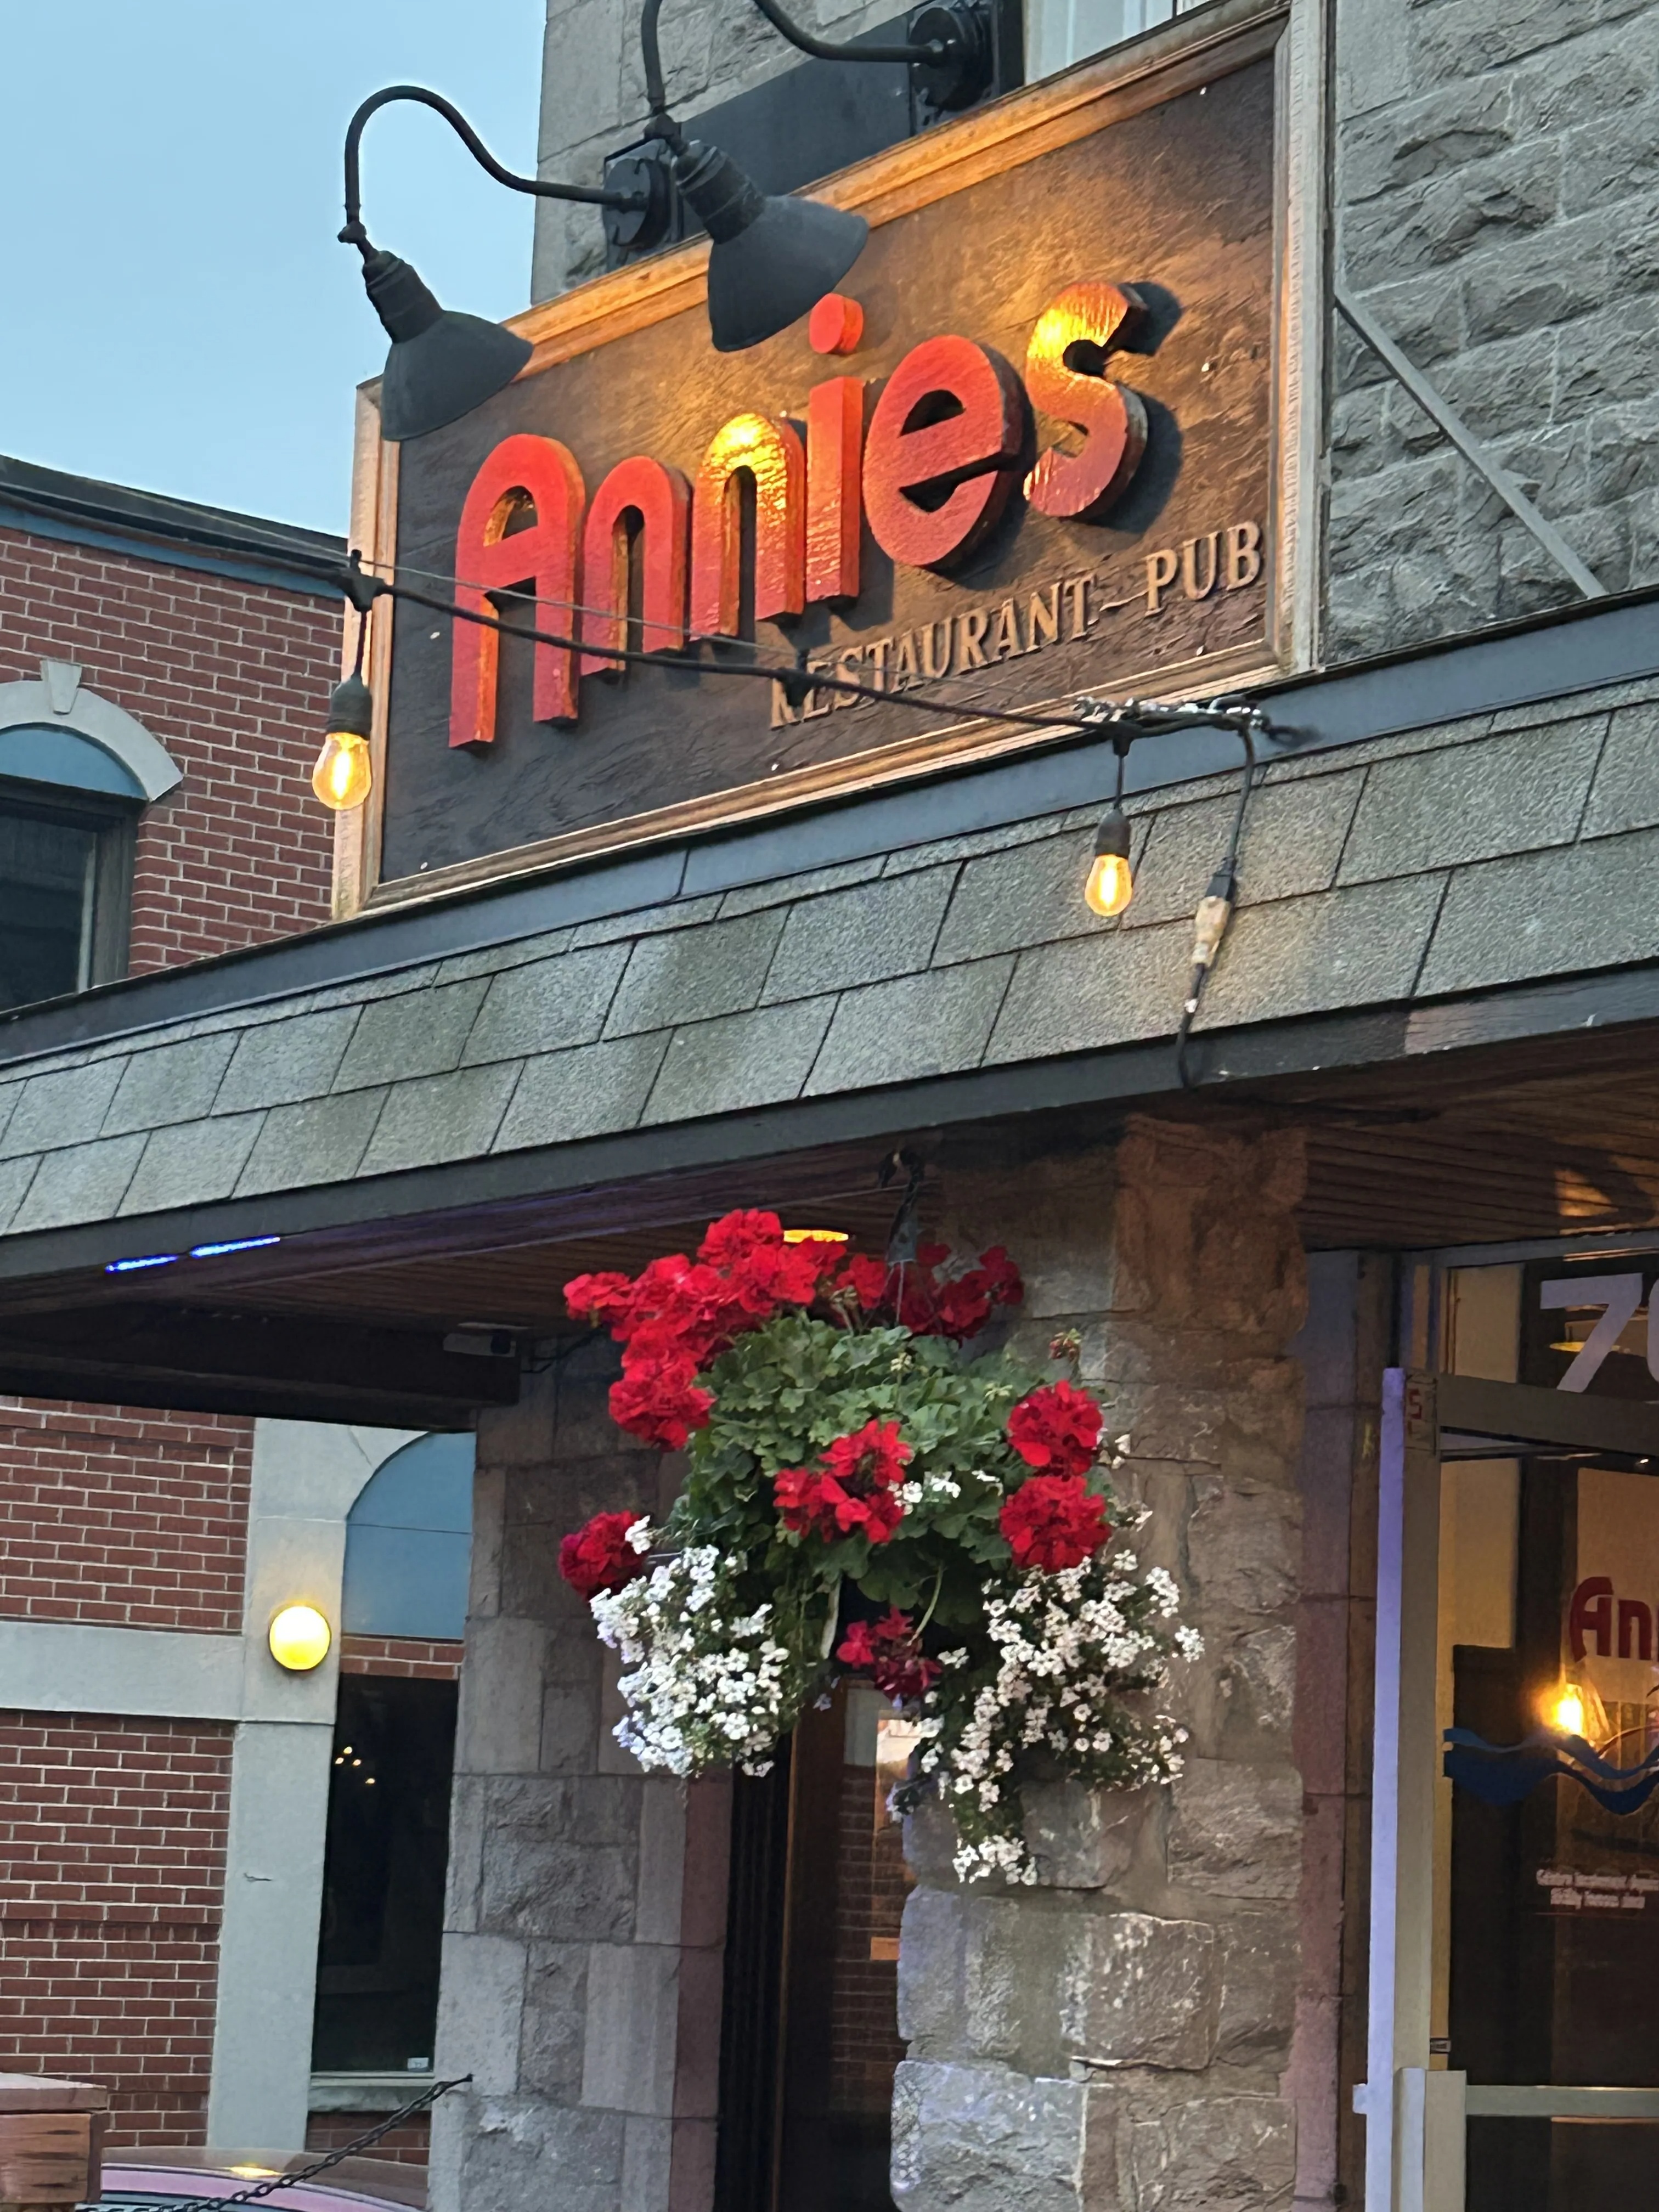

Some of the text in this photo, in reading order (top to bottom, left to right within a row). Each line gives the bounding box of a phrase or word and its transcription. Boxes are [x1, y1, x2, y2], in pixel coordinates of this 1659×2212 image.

[449, 281, 1148, 748] Annies
[1144, 521, 1261, 618] PUB
[1541, 1272, 1659, 1393] 7
[1570, 1576, 1659, 1663] An
